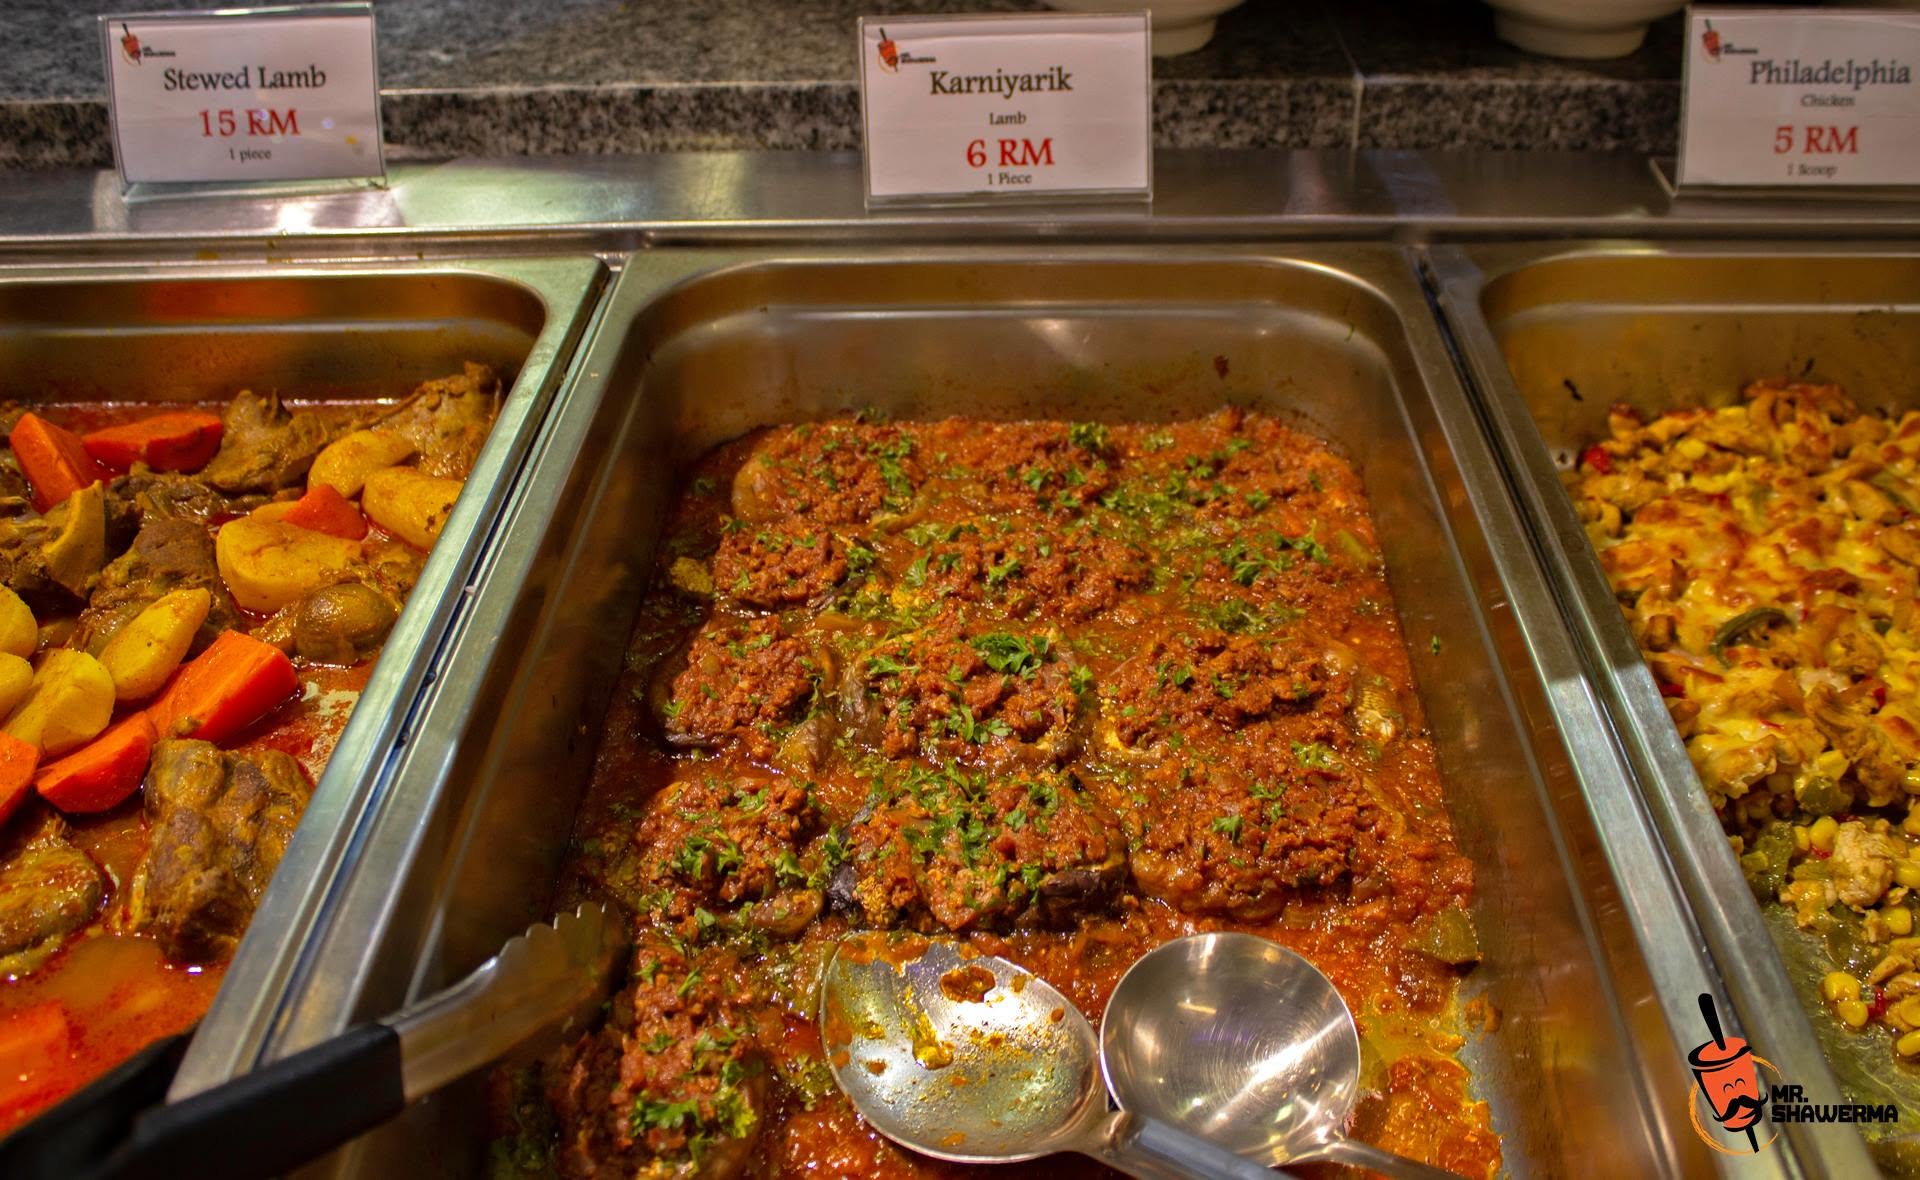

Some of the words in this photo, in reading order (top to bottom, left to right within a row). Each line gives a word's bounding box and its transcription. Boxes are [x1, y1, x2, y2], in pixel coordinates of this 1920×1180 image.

[164, 66, 250, 91] Stewed
[258, 64, 326, 89] Lamb
[930, 66, 1072, 99] Karniyarik
[1750, 59, 1911, 89] Philadelphia
[1801, 95, 1855, 107] Chicken
[199, 109, 236, 137] 15
[247, 109, 300, 136] RM
[989, 112, 1026, 126] Lamb
[967, 140, 987, 168] 6
[999, 138, 1054, 167] RM
[1774, 126, 1794, 154] 5
[1803, 126, 1858, 154] RM
[230, 149, 235, 160] 1
[240, 148, 271, 163] piece
[988, 173, 992, 185] 1
[999, 171, 1032, 185] Piece
[1788, 164, 1792, 176] 1
[1799, 163, 1838, 178] Scoop
